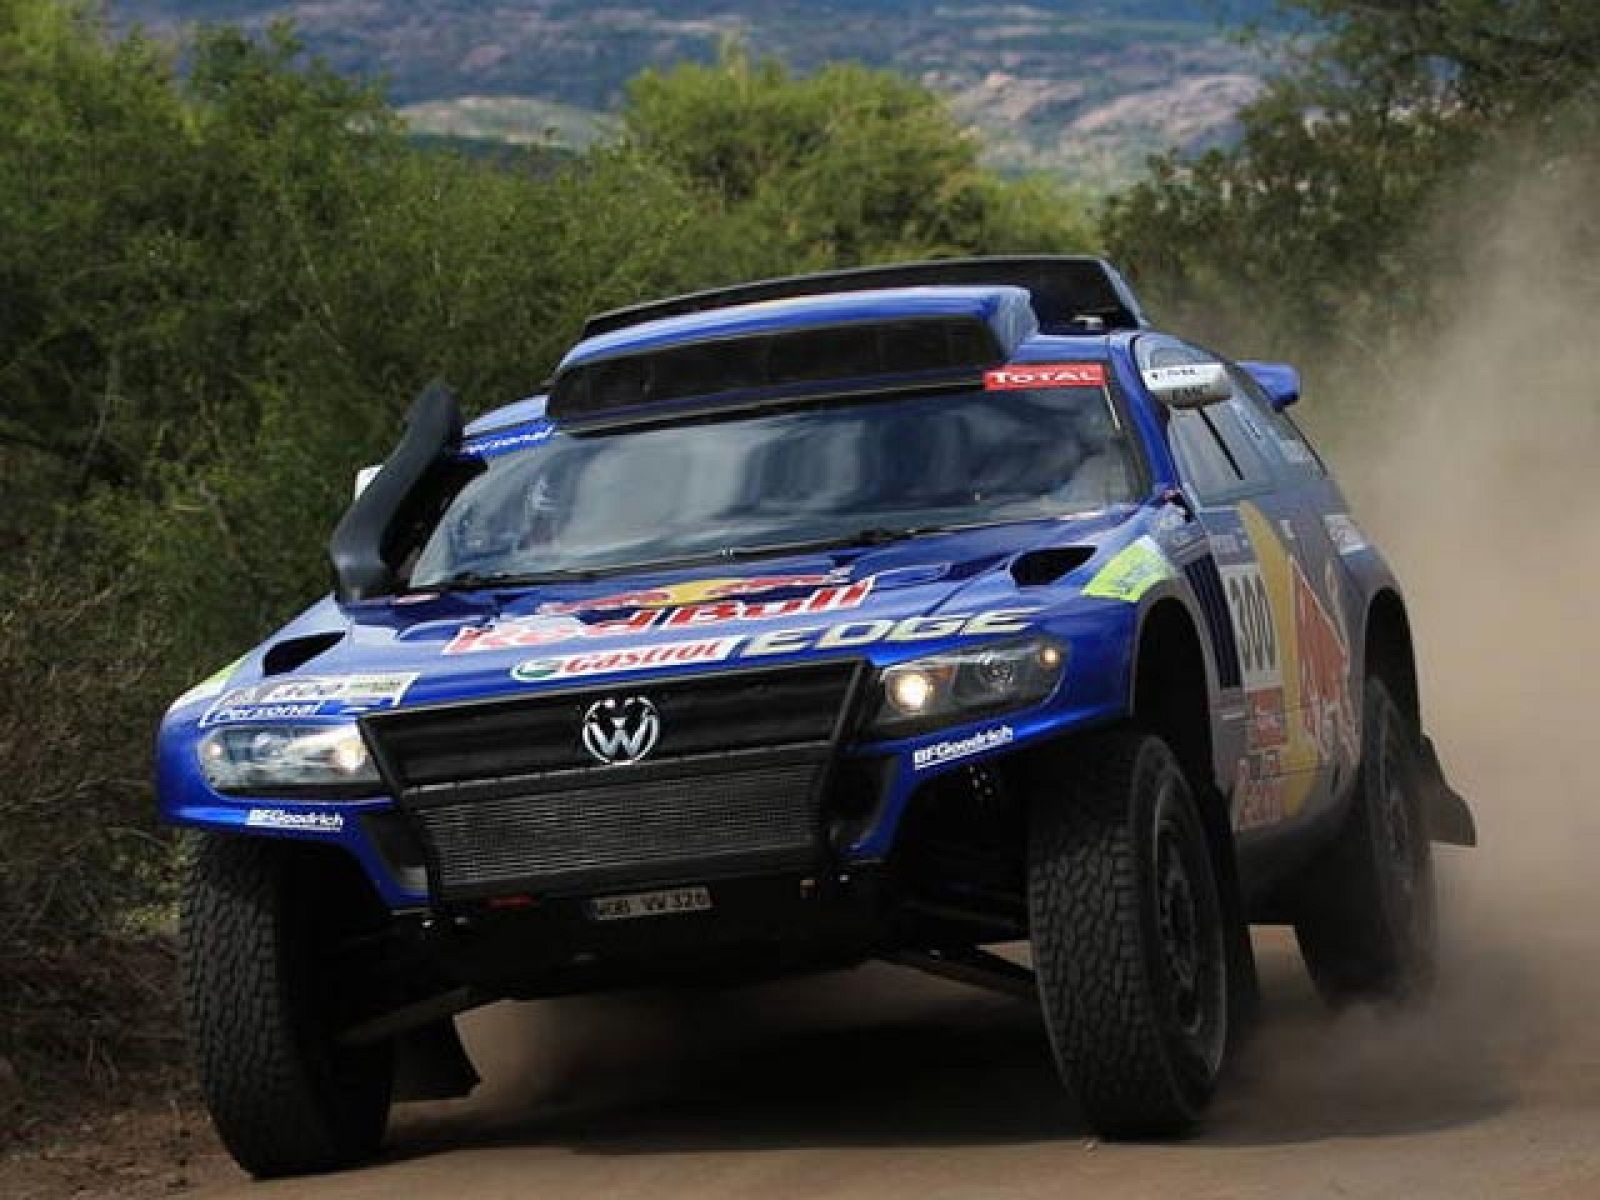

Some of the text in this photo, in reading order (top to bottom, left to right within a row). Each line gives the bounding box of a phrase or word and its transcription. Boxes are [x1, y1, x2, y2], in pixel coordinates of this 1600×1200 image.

[990, 368, 1098, 384] TOTAL
[660, 575, 876, 630] Bull
[564, 606, 1046, 673] Castrol EDGE
